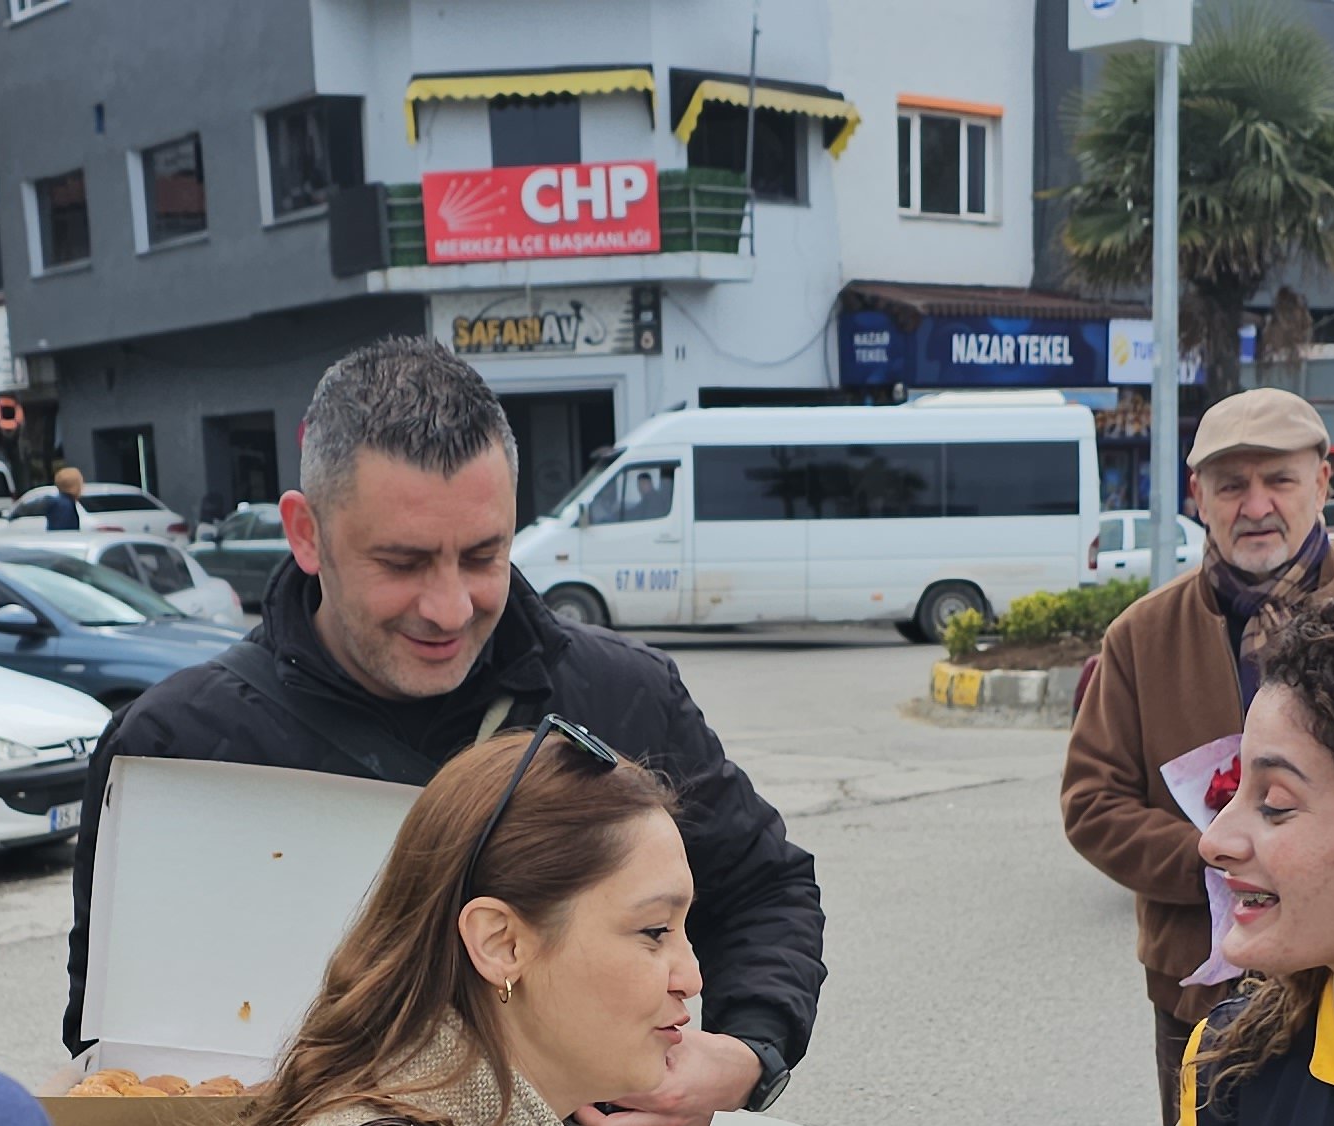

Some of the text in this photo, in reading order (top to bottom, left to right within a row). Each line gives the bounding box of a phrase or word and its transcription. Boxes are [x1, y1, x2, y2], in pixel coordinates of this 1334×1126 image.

[521, 165, 648, 224] CHP
[952, 333, 1073, 365] NAZAR TEKEL
